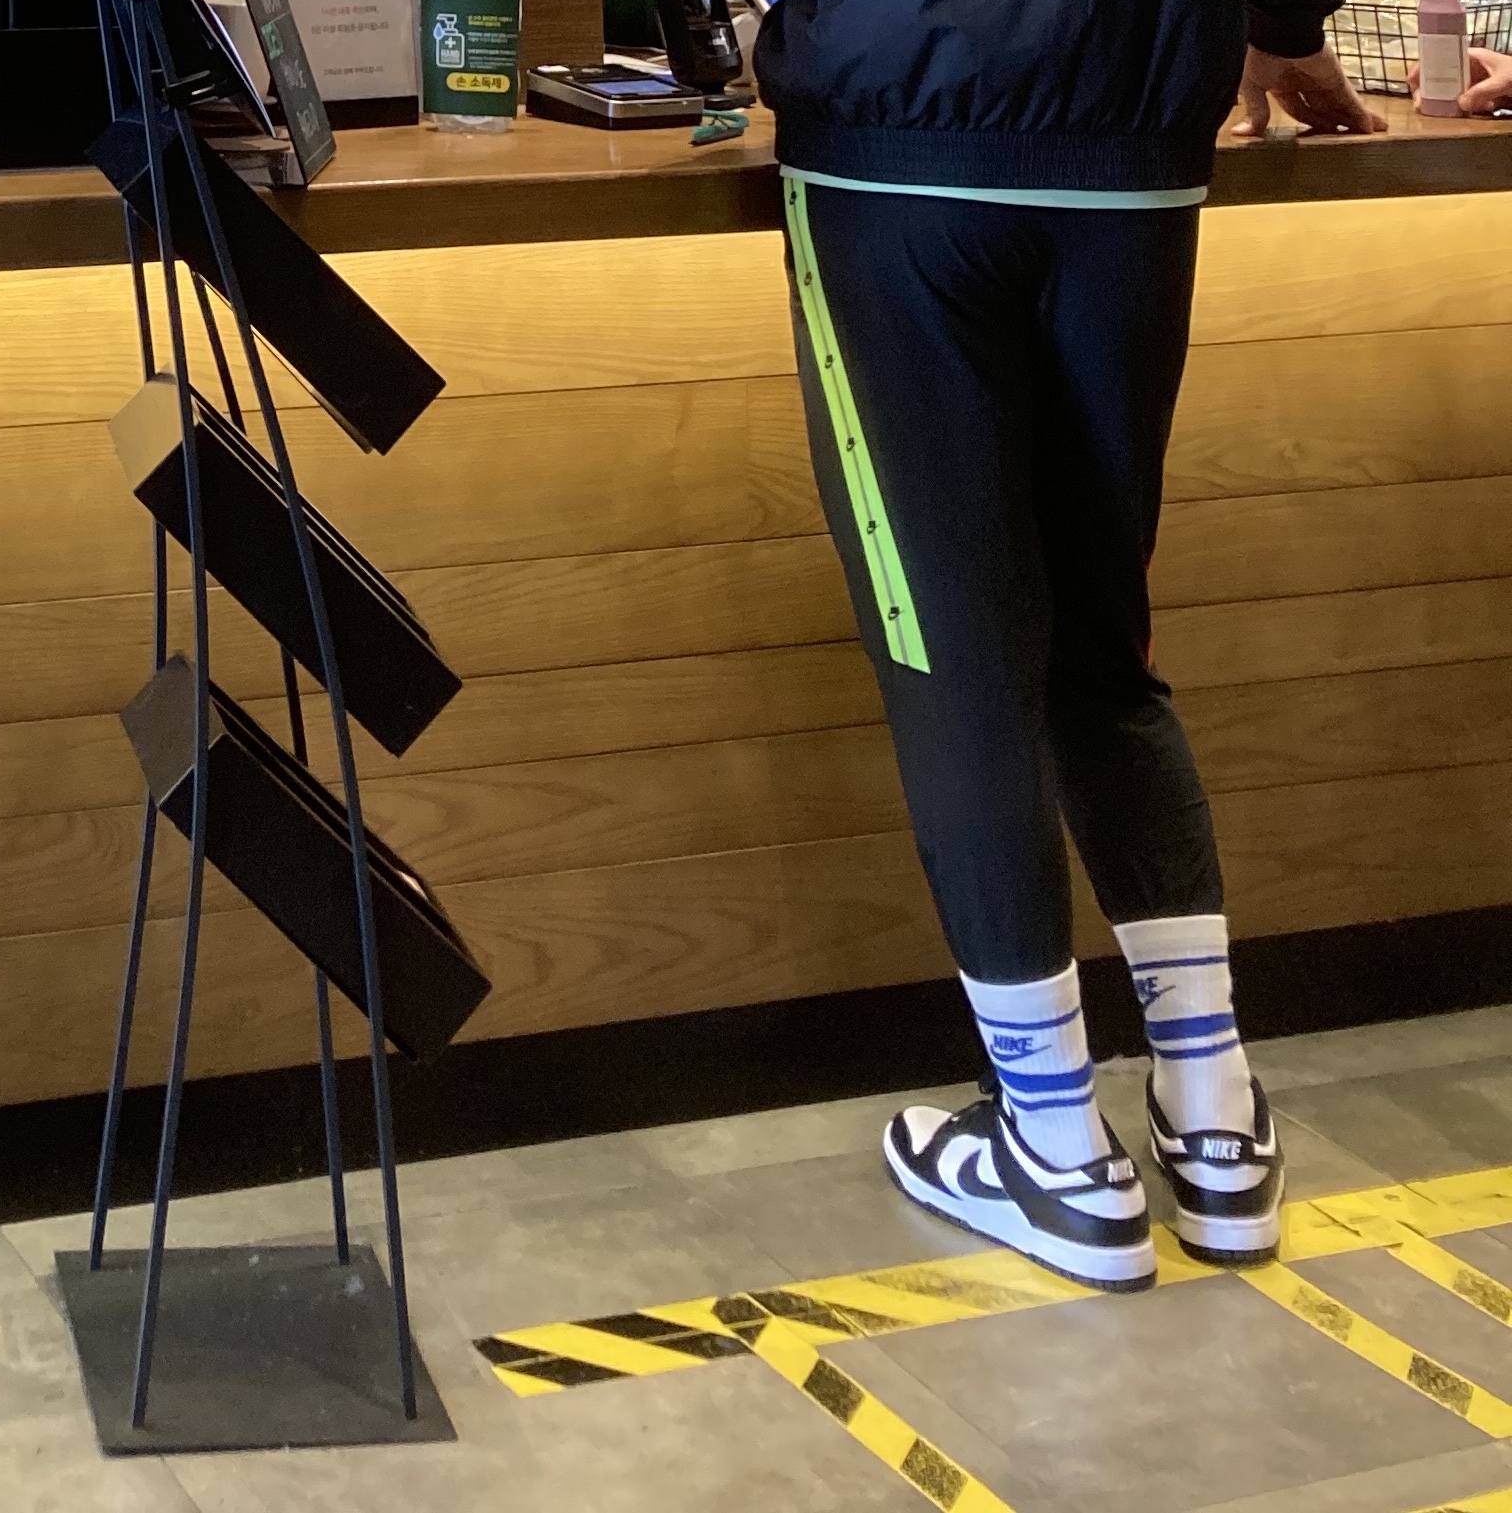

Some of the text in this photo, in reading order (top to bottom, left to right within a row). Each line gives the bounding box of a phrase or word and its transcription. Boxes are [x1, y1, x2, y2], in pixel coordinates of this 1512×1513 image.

[456, 75, 467, 88] 손
[992, 1034, 1033, 1052] NIKE
[1201, 1138, 1242, 1160] NIKE
